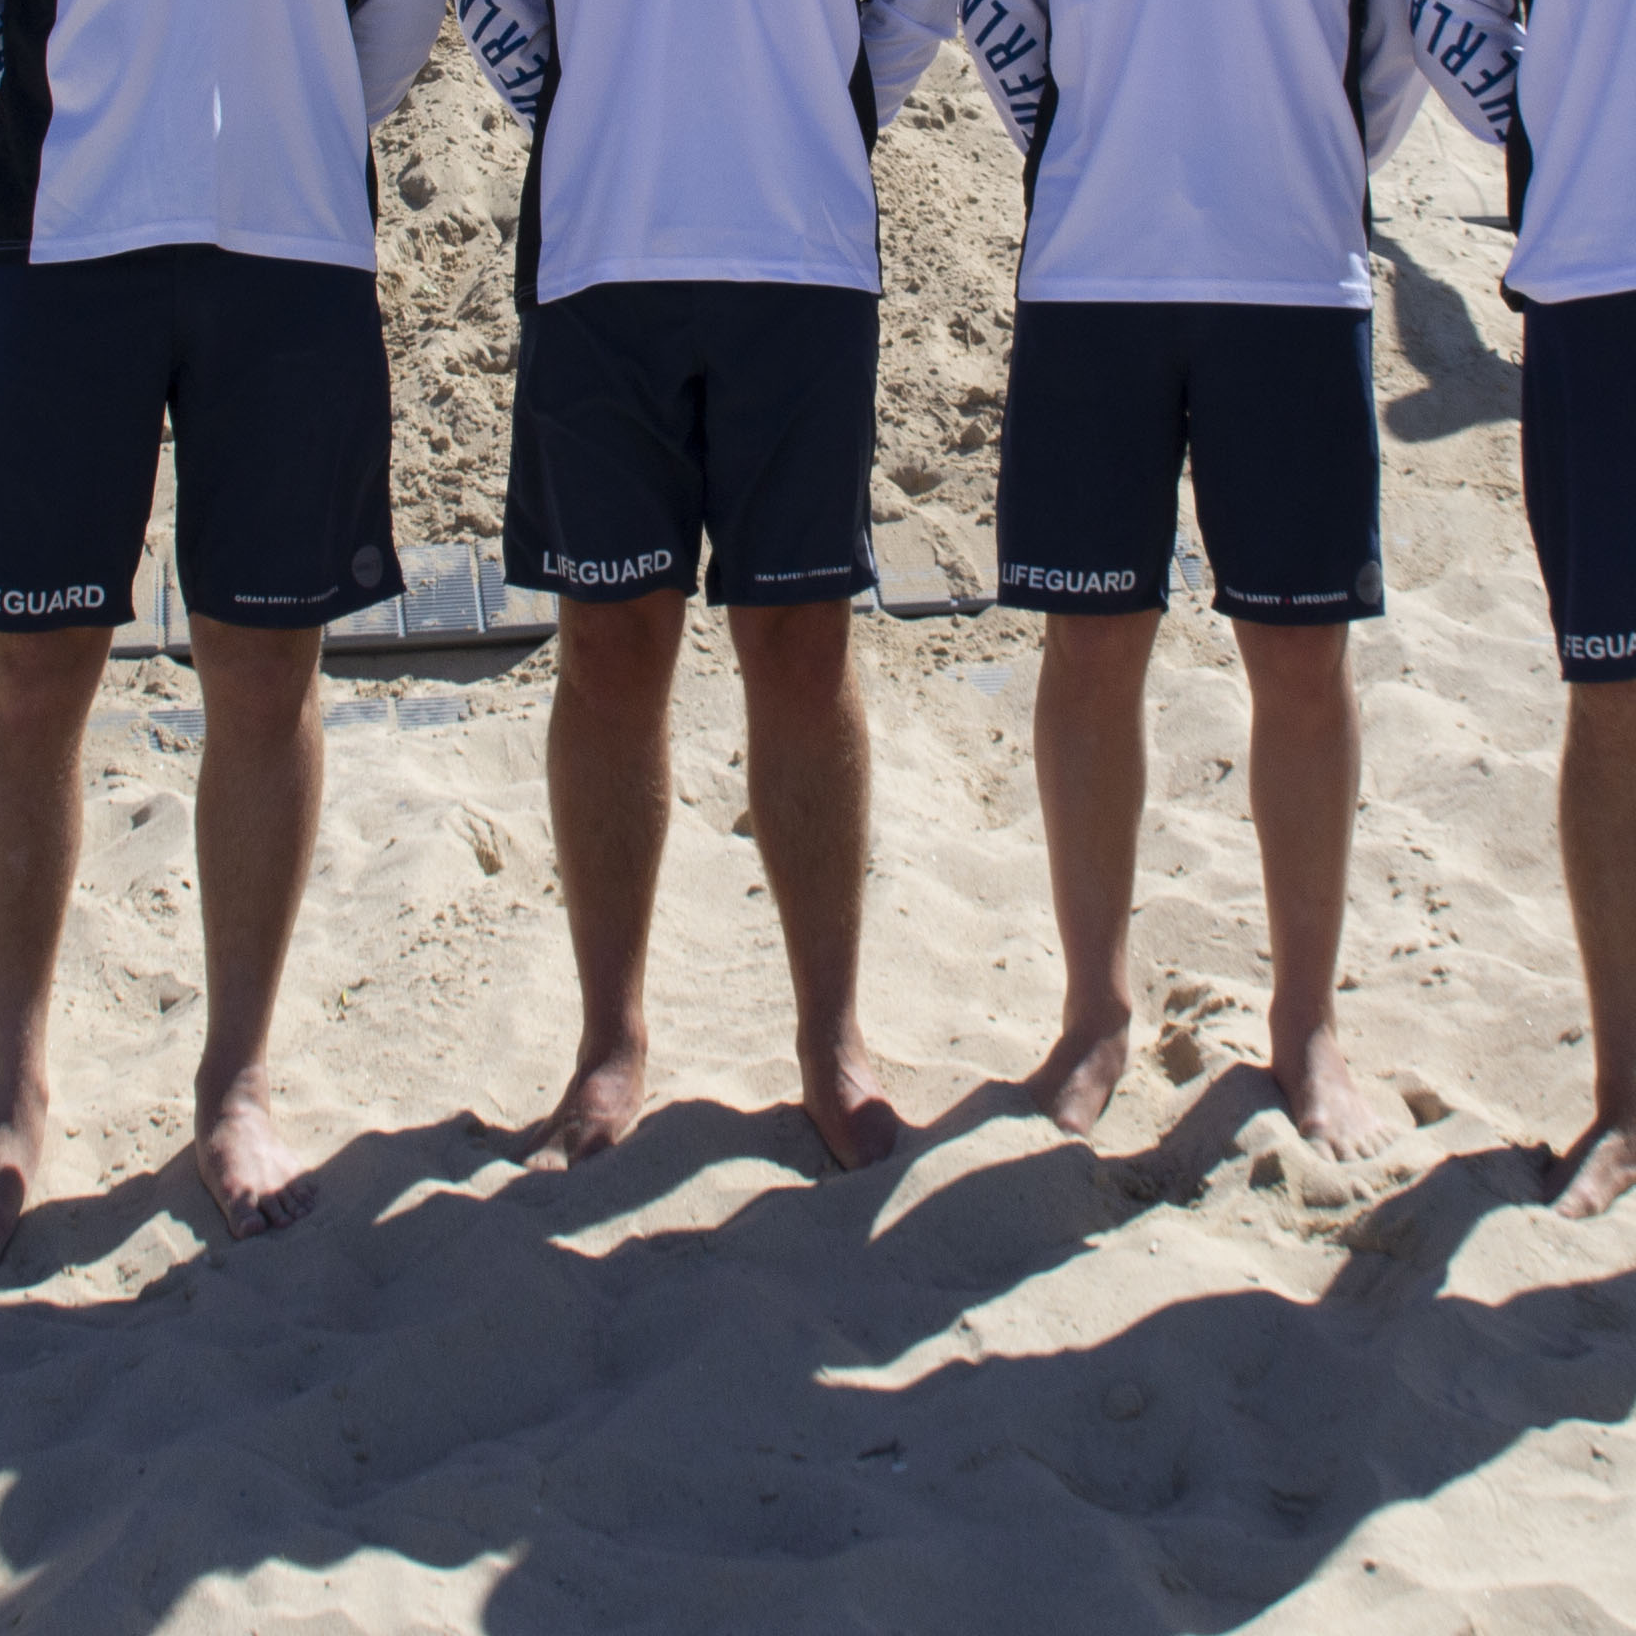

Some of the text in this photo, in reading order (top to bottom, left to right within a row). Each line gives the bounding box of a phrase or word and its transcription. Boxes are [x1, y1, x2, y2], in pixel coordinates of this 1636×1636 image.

[543, 550, 673, 585] LIFEGUARD
[1002, 562, 1137, 593] LIFEGUARD
[234, 593, 265, 605] OCEAN
[267, 595, 298, 605] SAFETY
[1246, 593, 1281, 605] SAFETY
[1292, 589, 1349, 605] LIFEGUARDS
